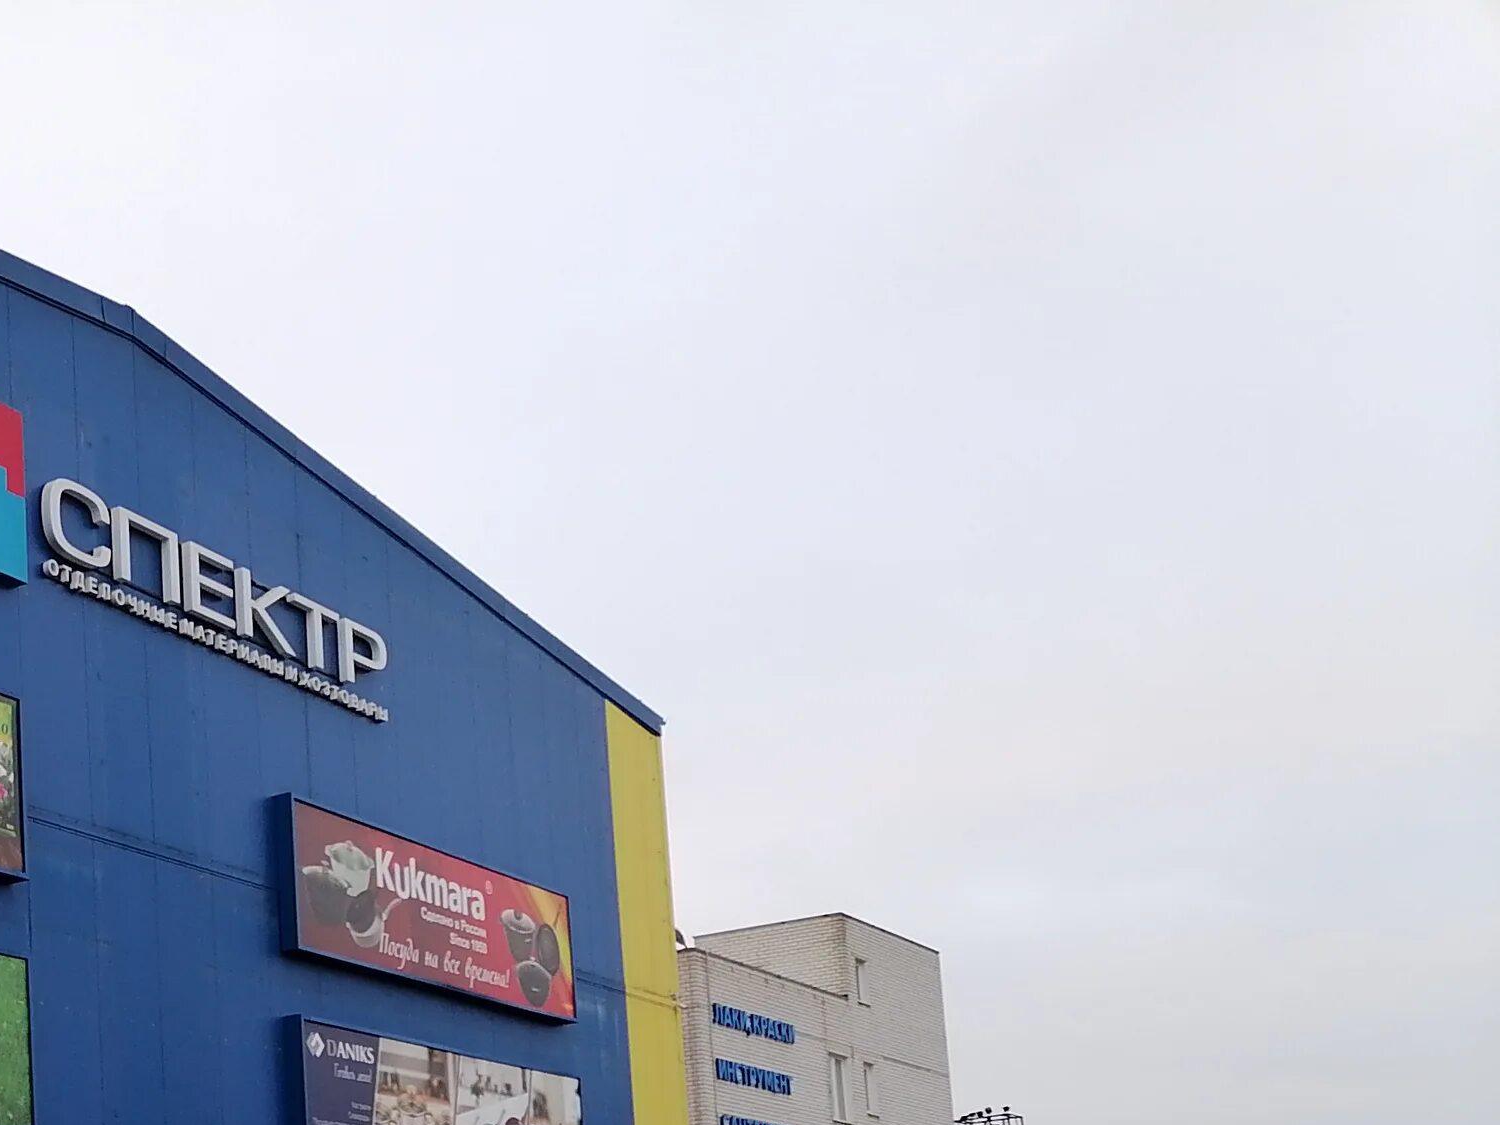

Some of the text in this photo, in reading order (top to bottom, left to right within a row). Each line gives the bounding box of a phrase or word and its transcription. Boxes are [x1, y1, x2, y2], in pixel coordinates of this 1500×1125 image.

[41, 477, 387, 683] СПЕКТР
[42, 558, 388, 722] ОТДЕЛОЧНЫЕ МАТЕРИАЛЫ И ХОЗТОВАРЫ
[375, 847, 486, 921] Kukmara
[379, 932, 510, 988] Посуда на все времена!
[325, 1039, 375, 1064] DANIKS
[715, 1057, 793, 1095] ИНСТРУМЕНТ
